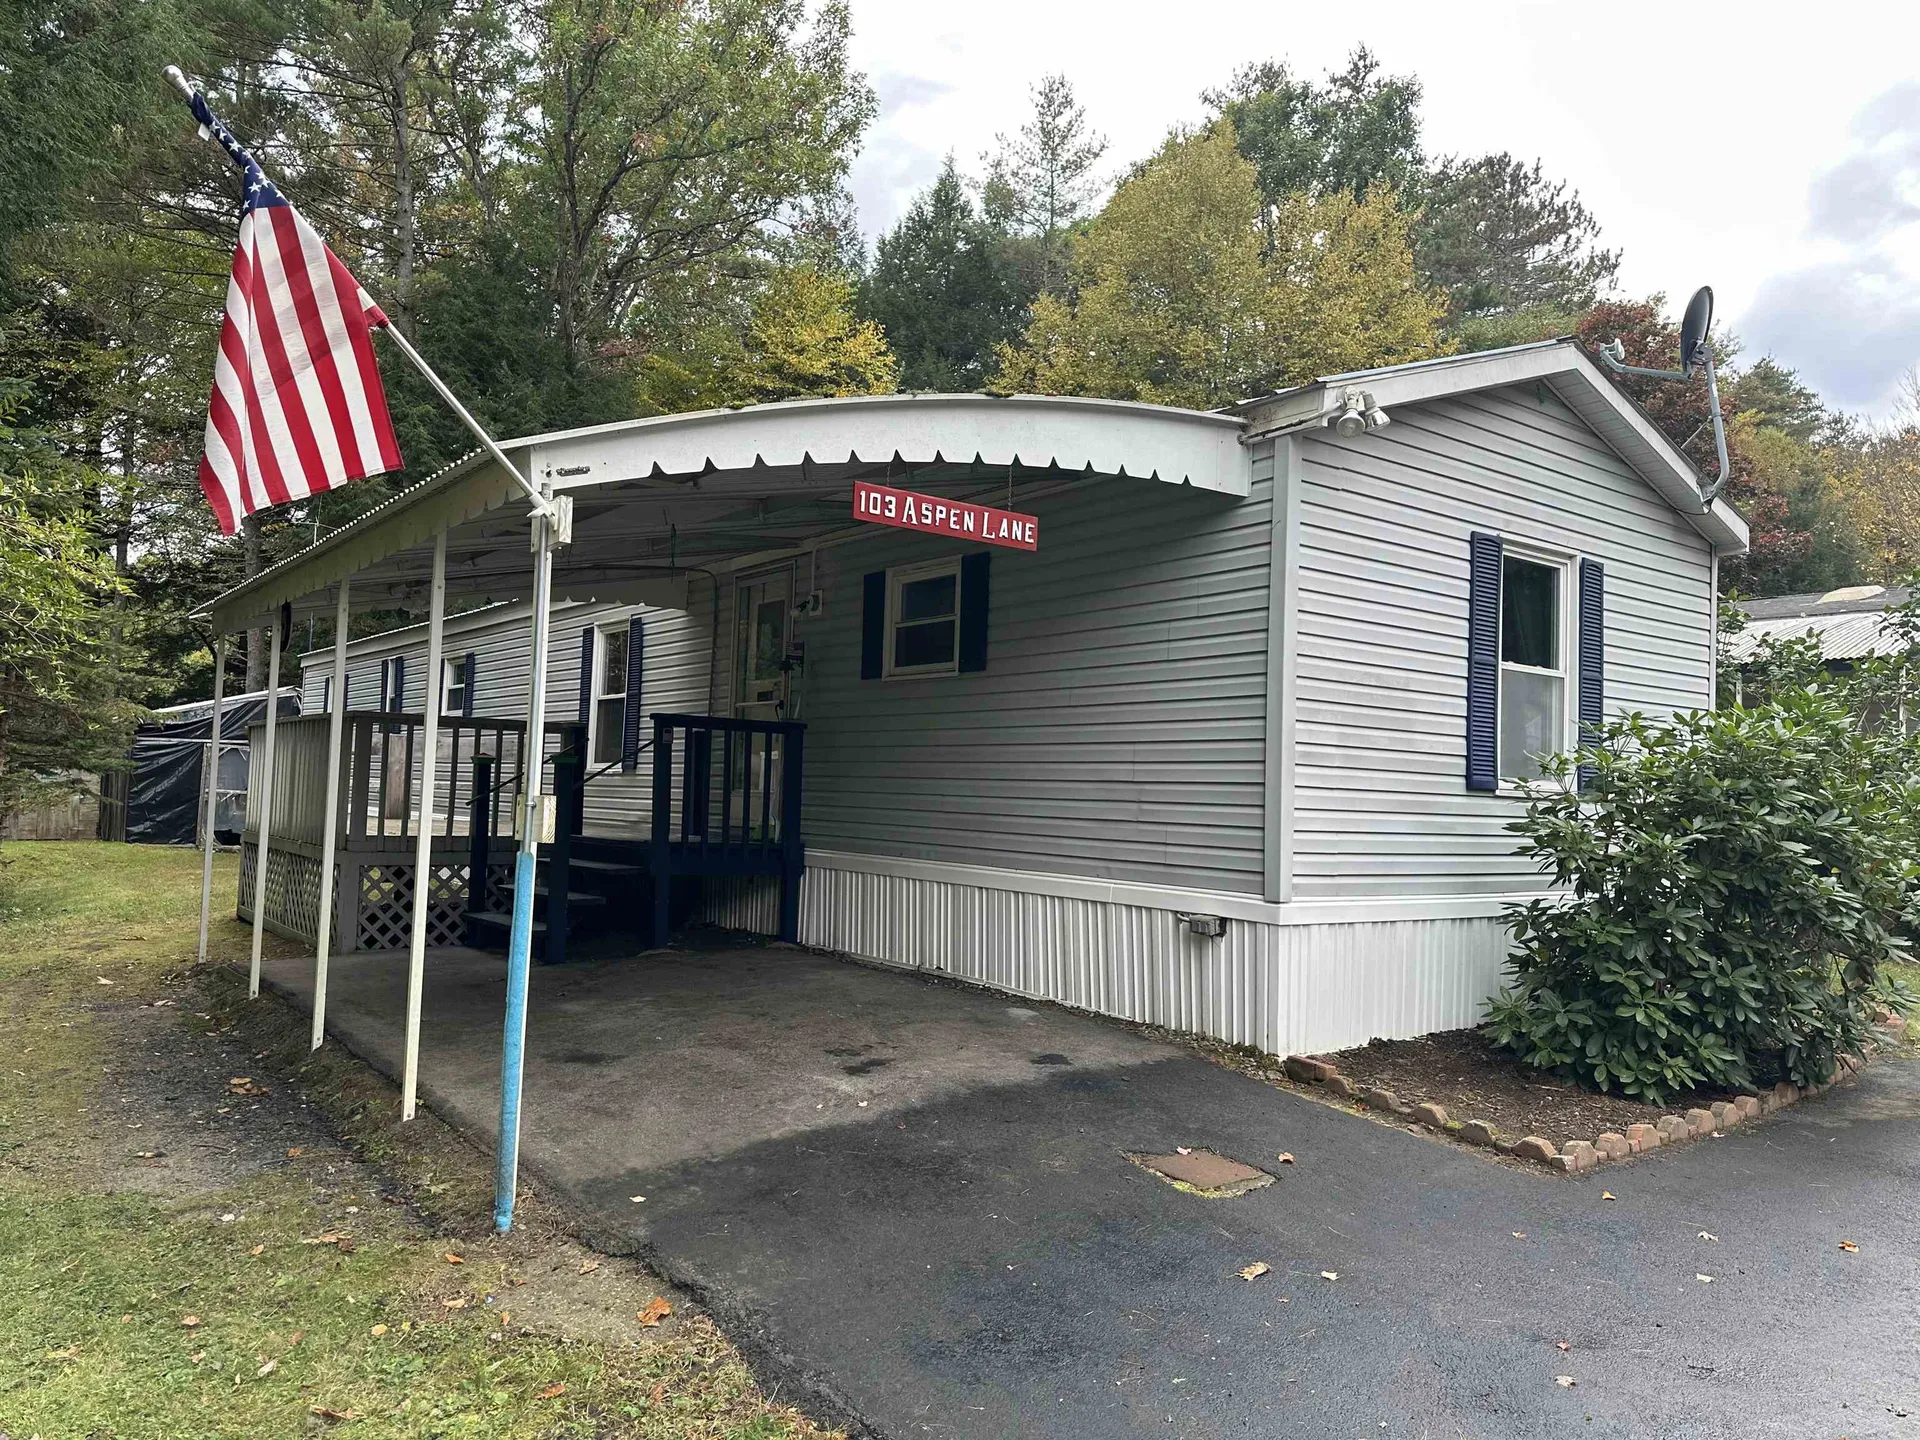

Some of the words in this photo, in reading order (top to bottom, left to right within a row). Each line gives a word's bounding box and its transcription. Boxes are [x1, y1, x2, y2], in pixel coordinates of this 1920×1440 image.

[859, 490, 897, 518] 103
[901, 495, 975, 533] ASPEN
[981, 511, 1035, 543] LANE
